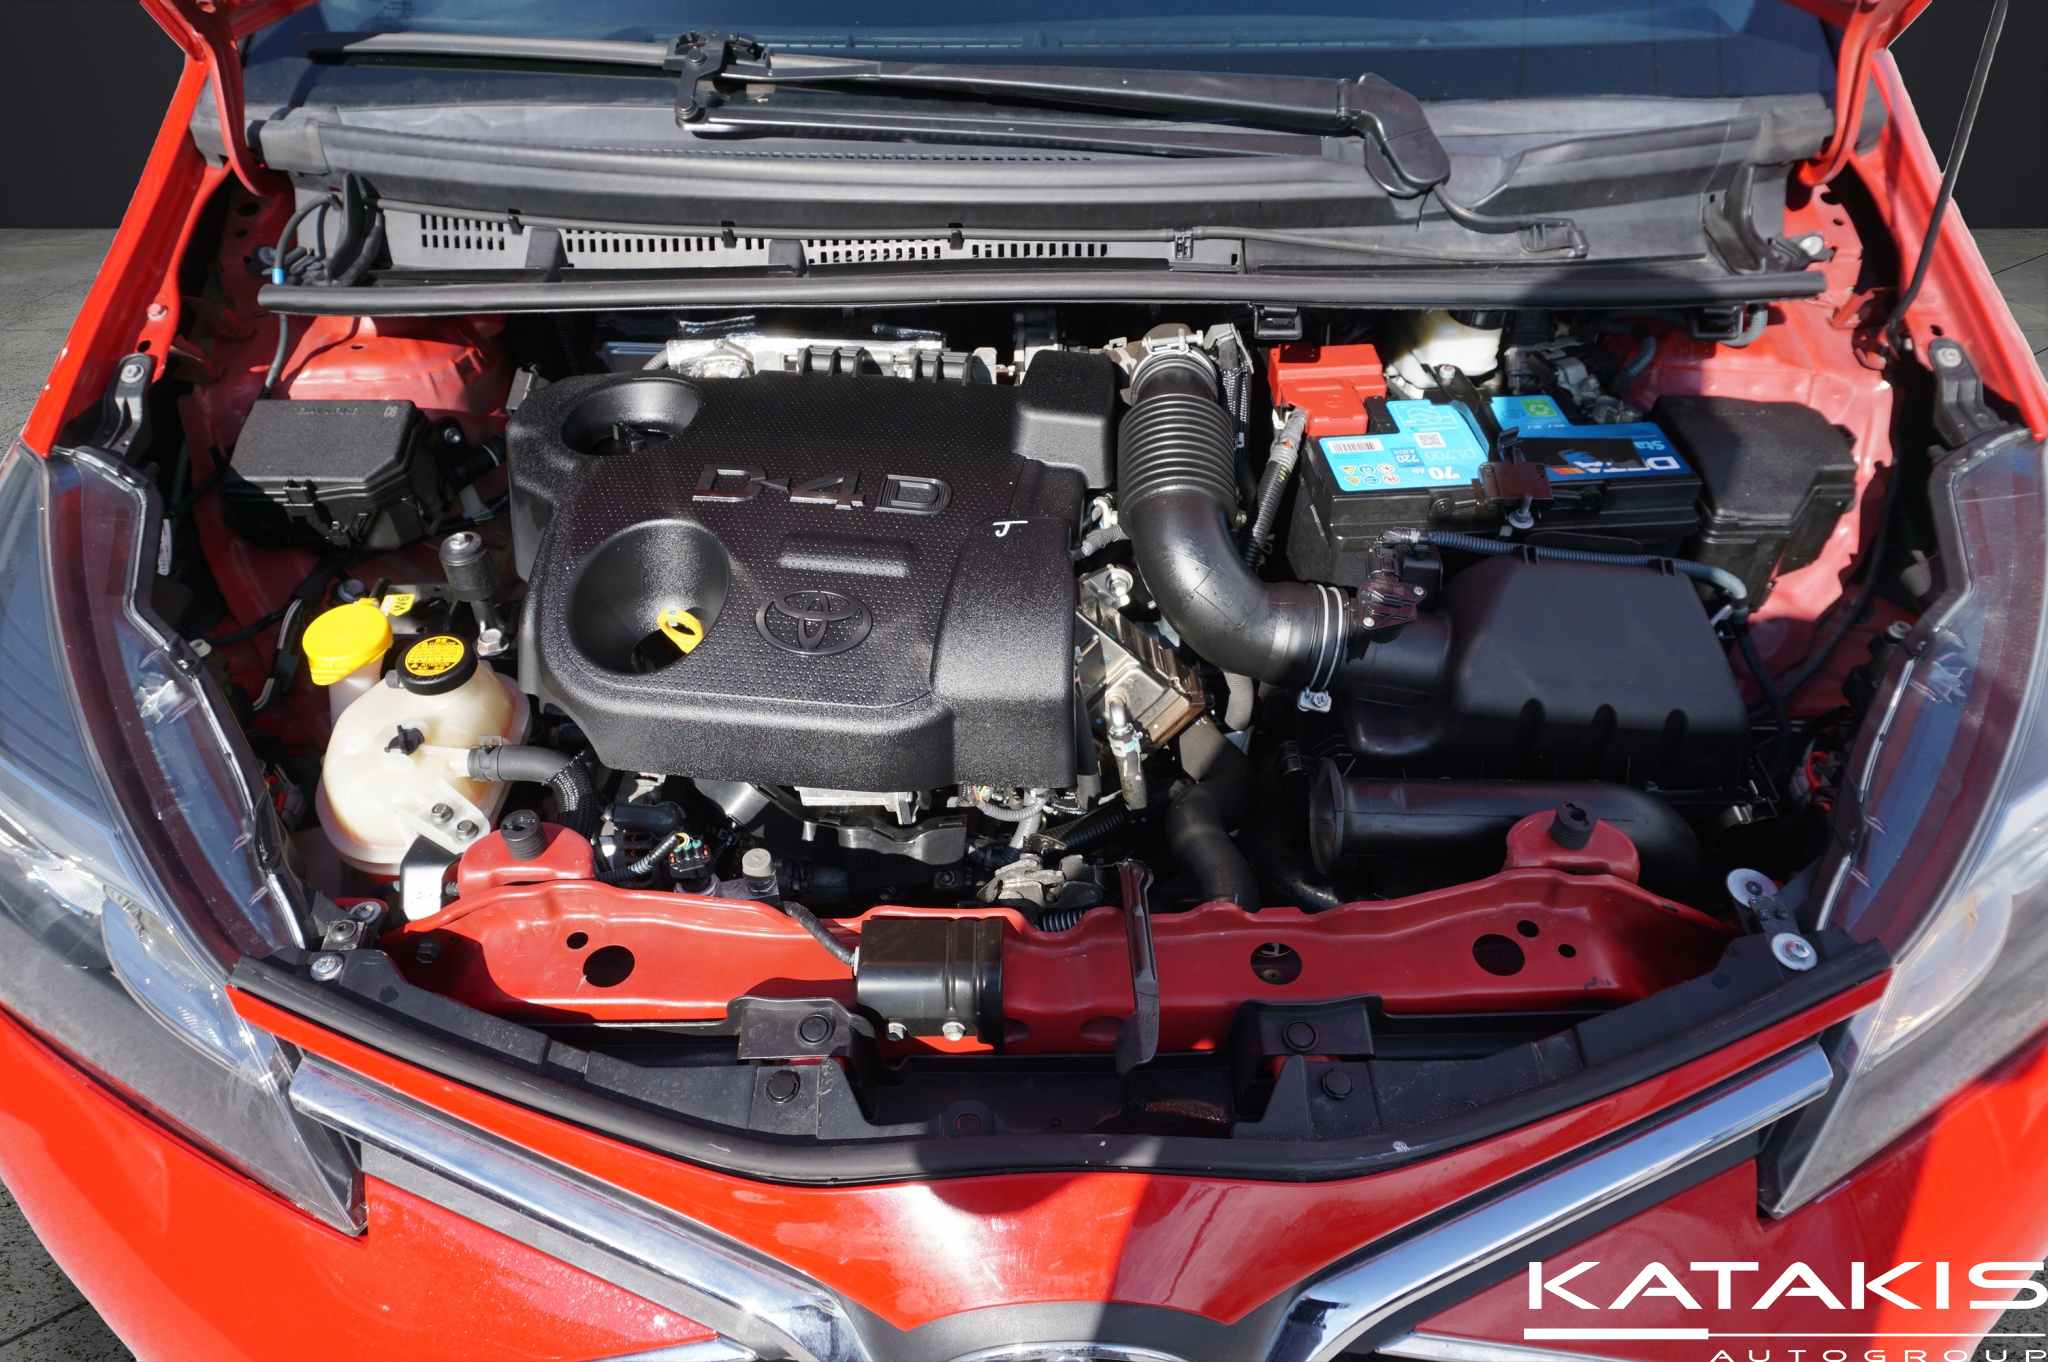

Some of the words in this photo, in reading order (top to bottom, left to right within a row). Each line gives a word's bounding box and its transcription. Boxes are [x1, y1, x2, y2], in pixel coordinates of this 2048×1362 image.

[1397, 453, 1420, 464] 720
[1428, 465, 1461, 481] 70
[992, 520, 1029, 538] J
